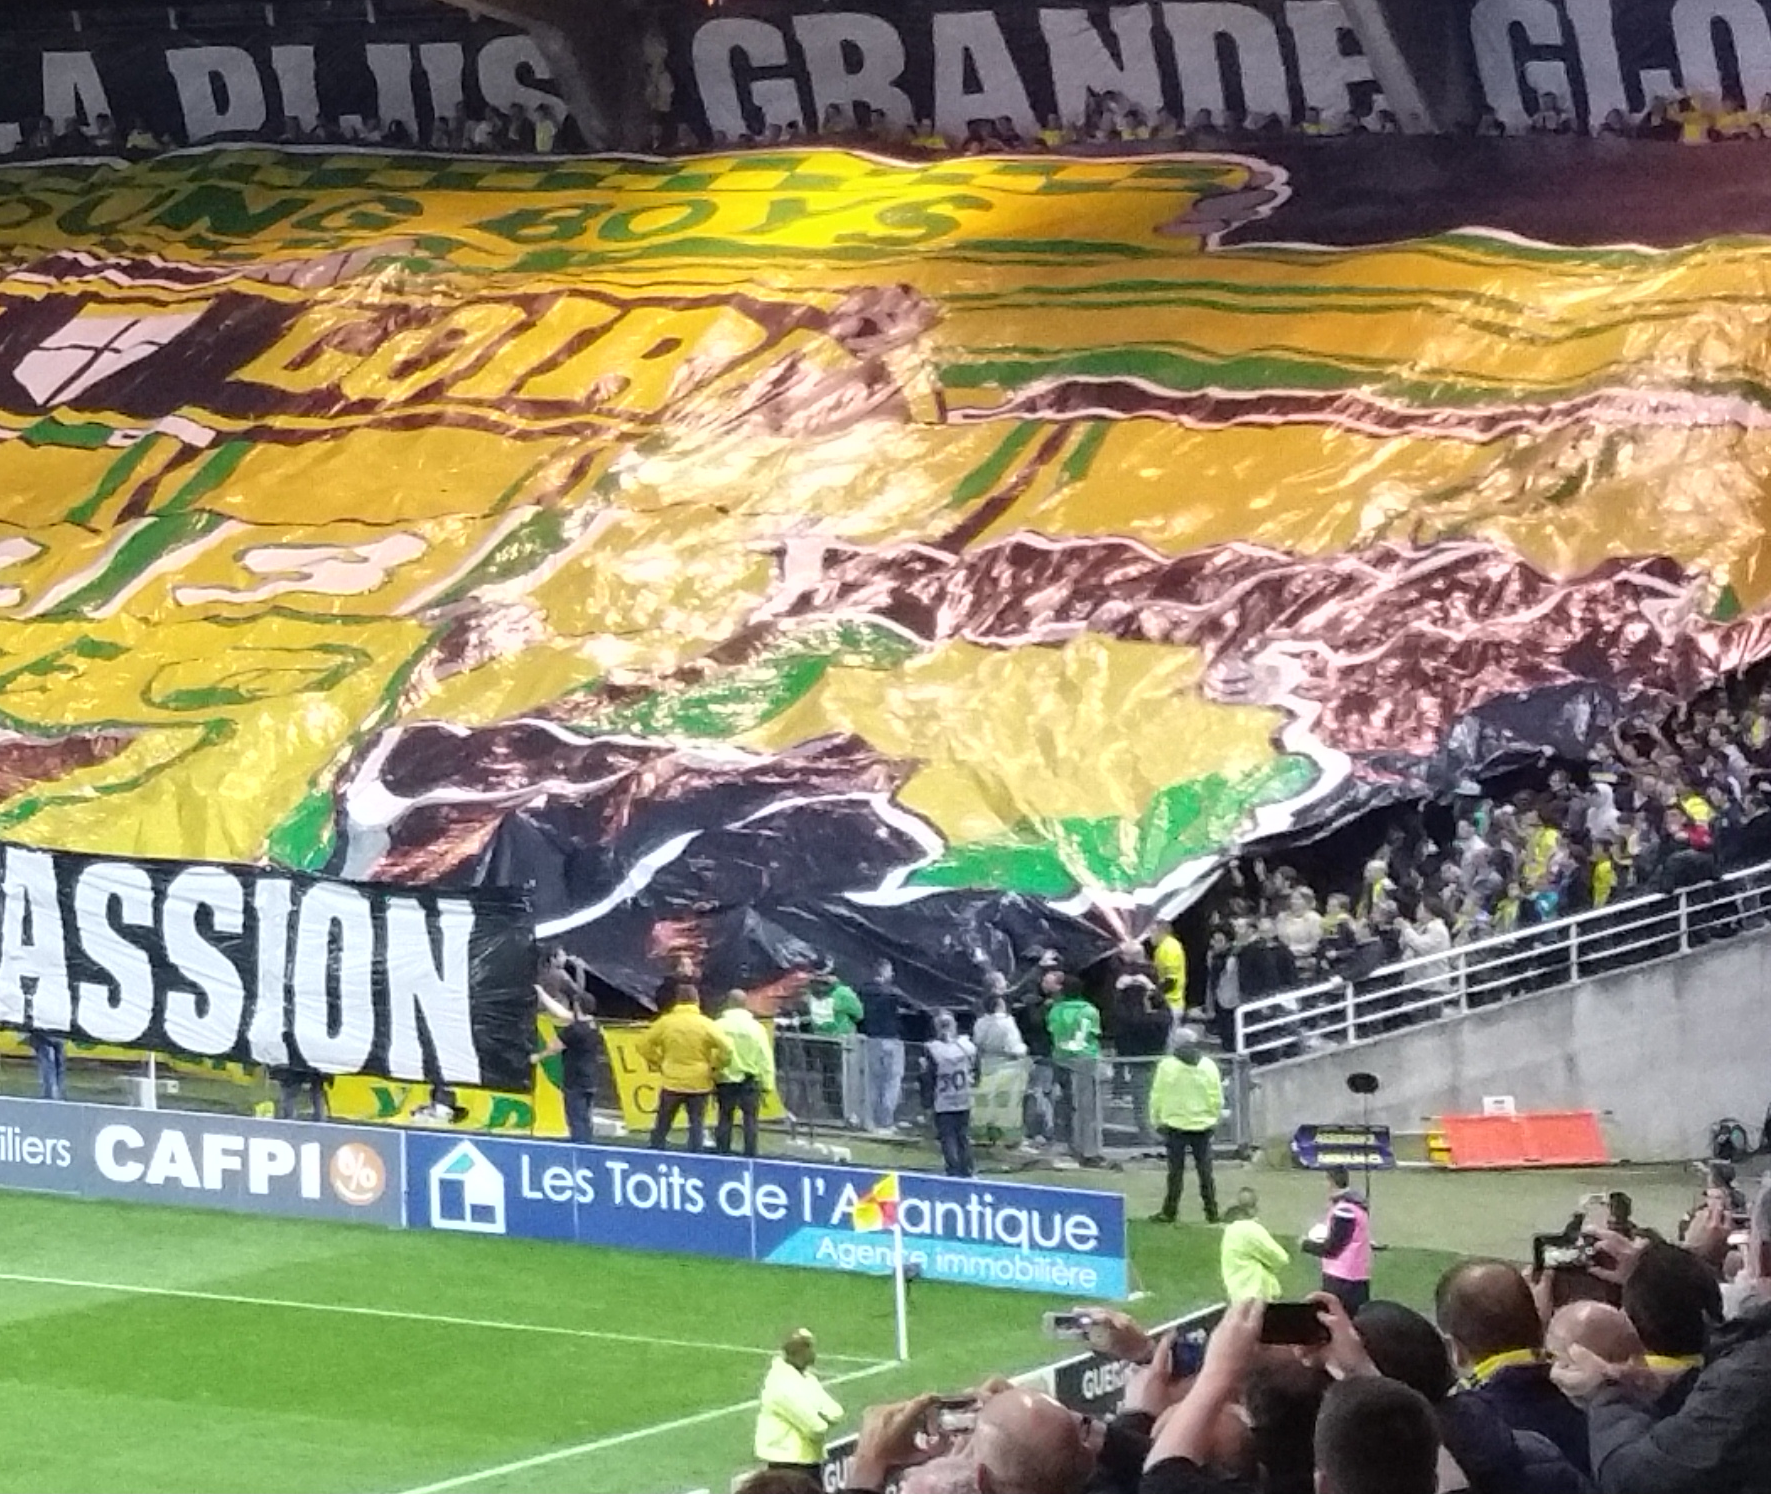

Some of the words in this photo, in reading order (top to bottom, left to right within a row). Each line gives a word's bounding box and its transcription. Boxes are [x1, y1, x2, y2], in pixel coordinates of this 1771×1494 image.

[692, 0, 1399, 136] GRANDE
[95, 1123, 321, 1199] CAFPI
[521, 1154, 594, 1204] Les
[605, 1161, 705, 1214] Toits
[719, 1171, 788, 1220] de
[804, 1178, 1099, 1252] l'Aantique
[936, 1248, 1098, 1289] immobilière
